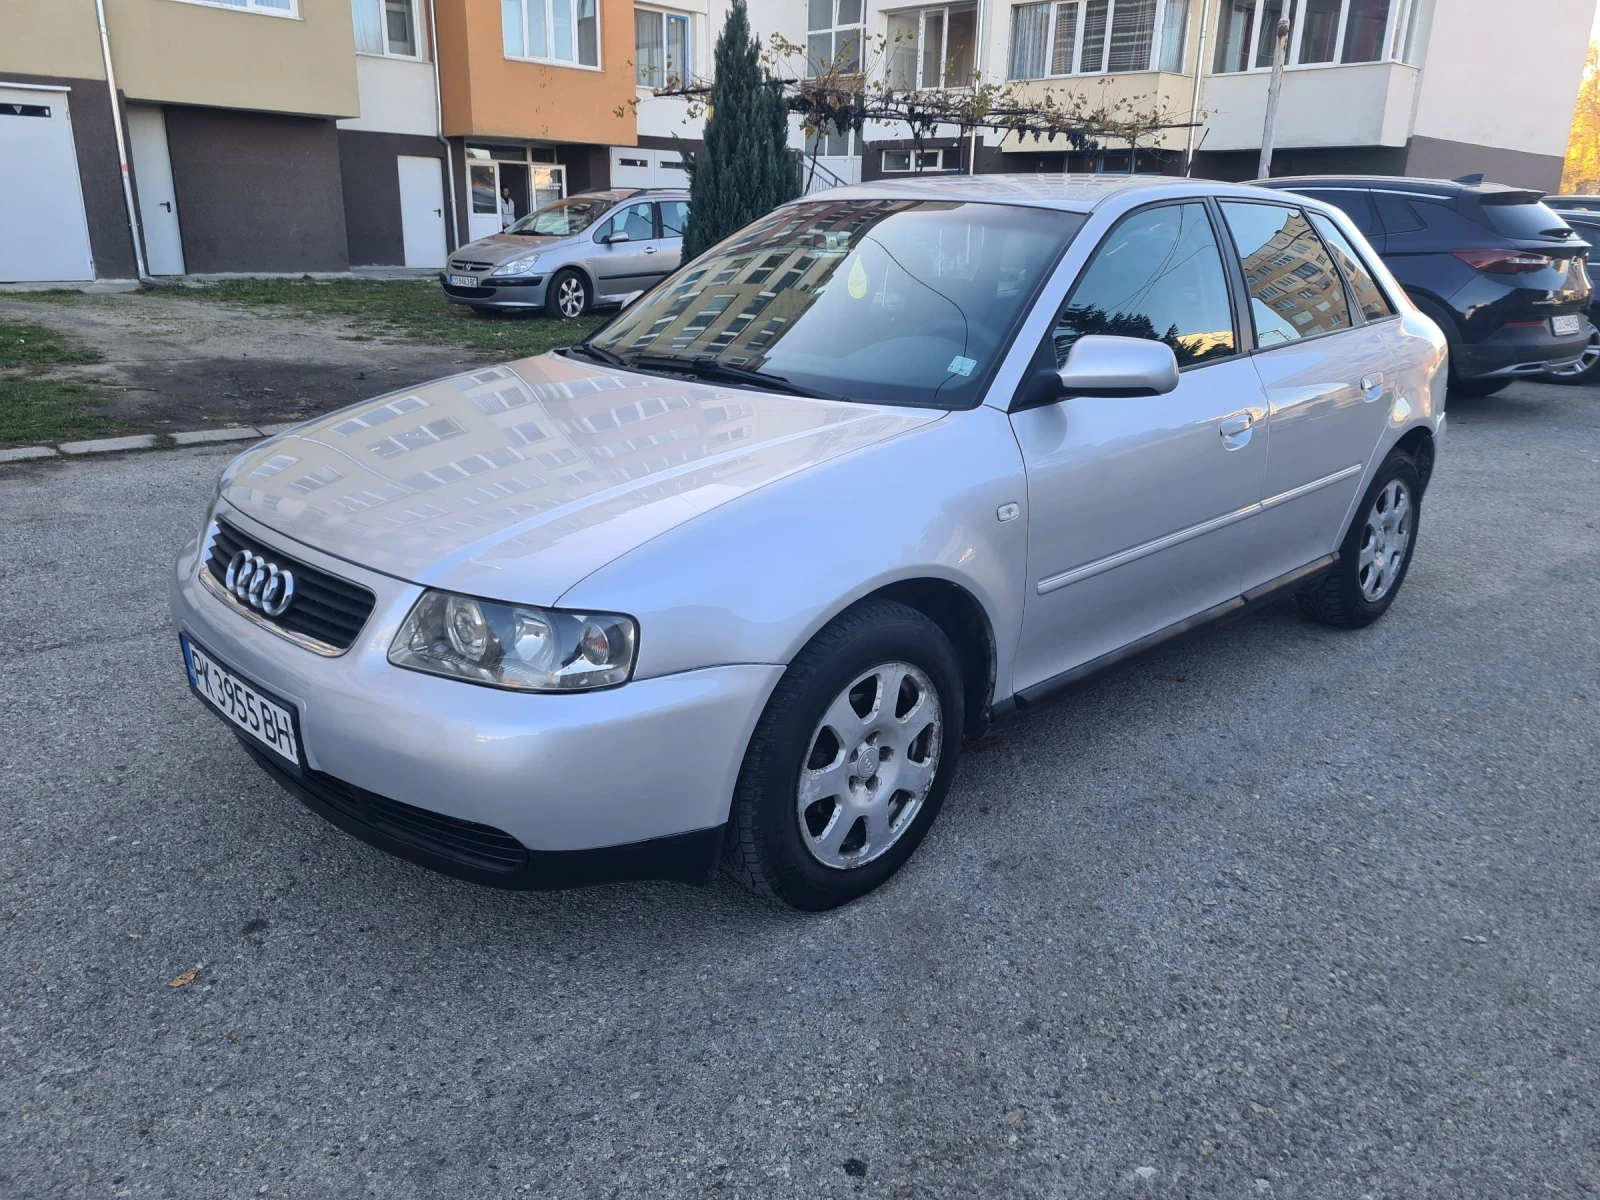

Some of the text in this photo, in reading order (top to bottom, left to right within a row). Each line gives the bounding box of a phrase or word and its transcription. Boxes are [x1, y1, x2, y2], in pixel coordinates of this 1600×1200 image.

[191, 649, 294, 756] PK 3955 BH
